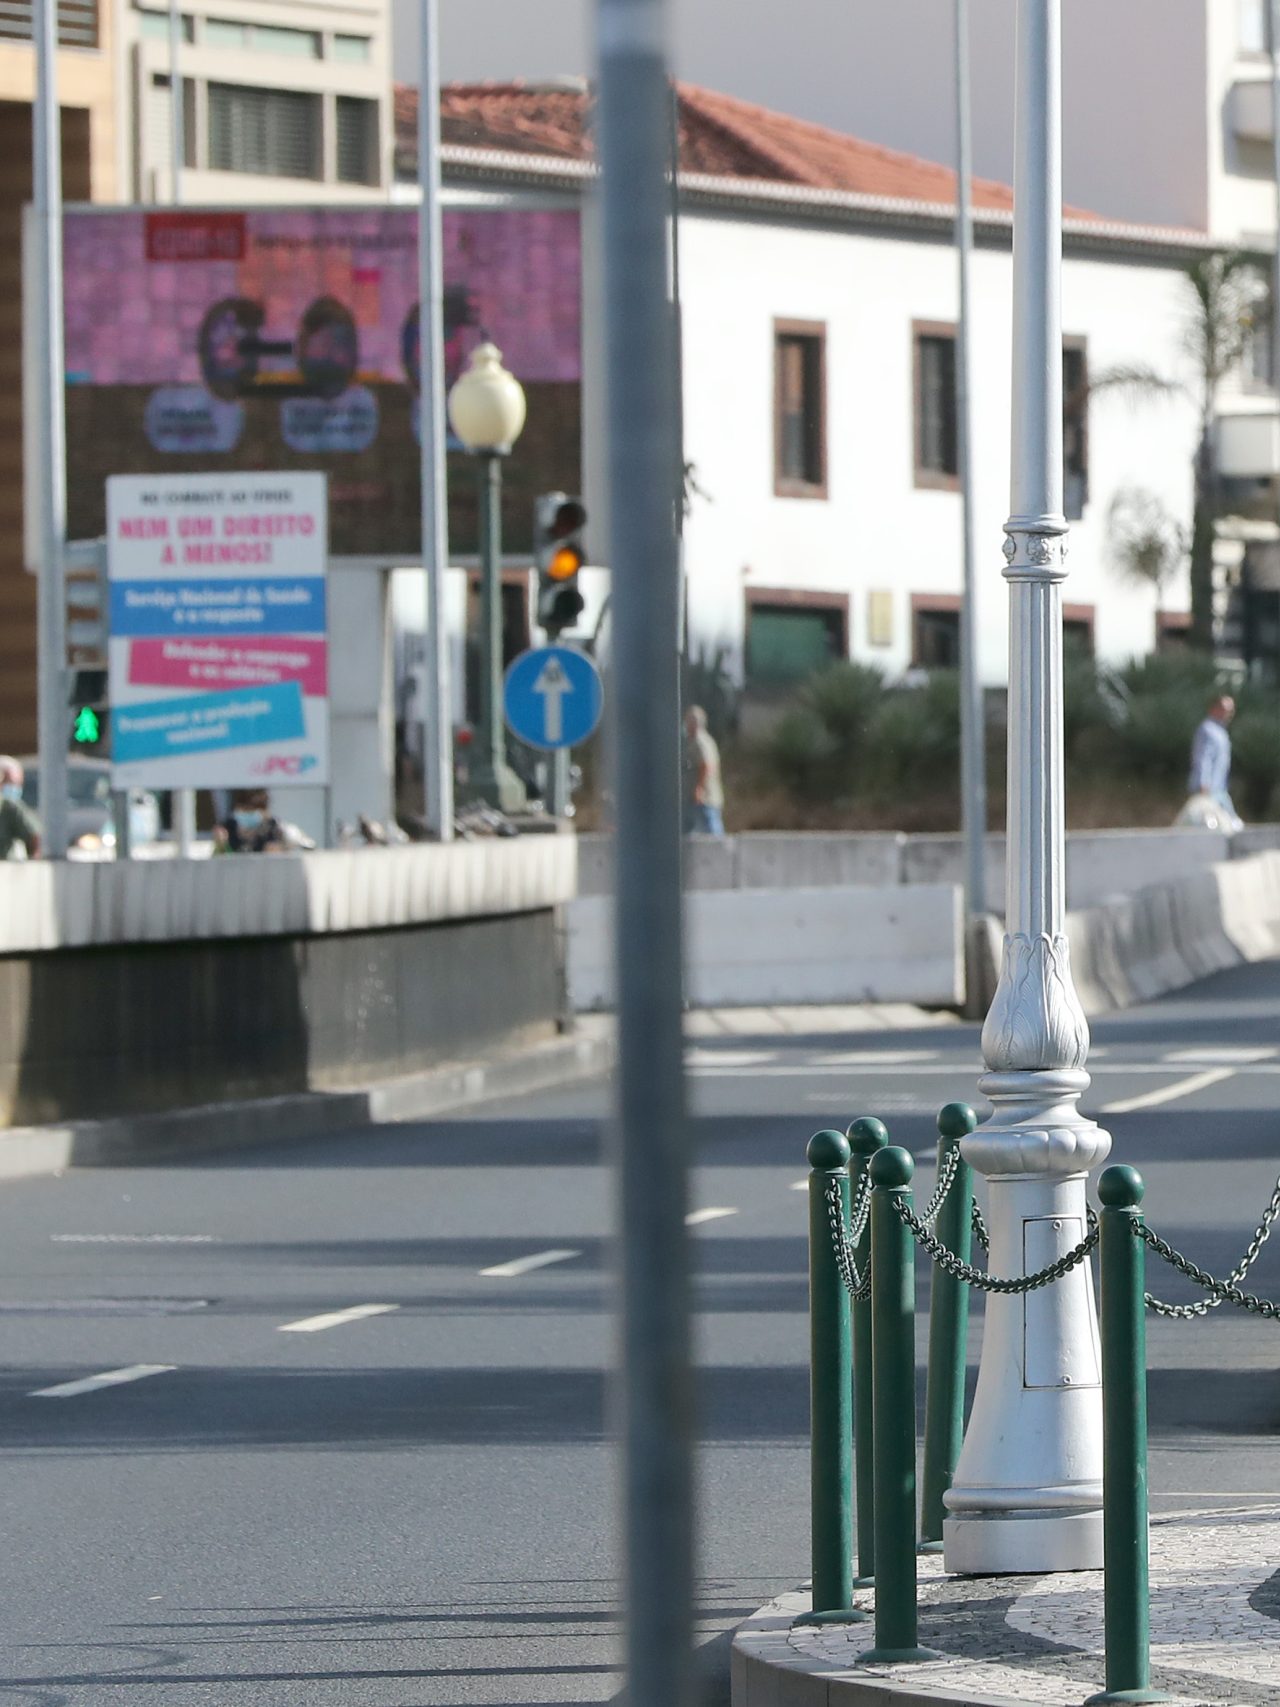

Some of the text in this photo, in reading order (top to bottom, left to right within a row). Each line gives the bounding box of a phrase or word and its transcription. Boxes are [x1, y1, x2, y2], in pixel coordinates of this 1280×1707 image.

[119, 513, 315, 538] NEM UM DIREITO
[161, 542, 272, 564] A MENOS!
